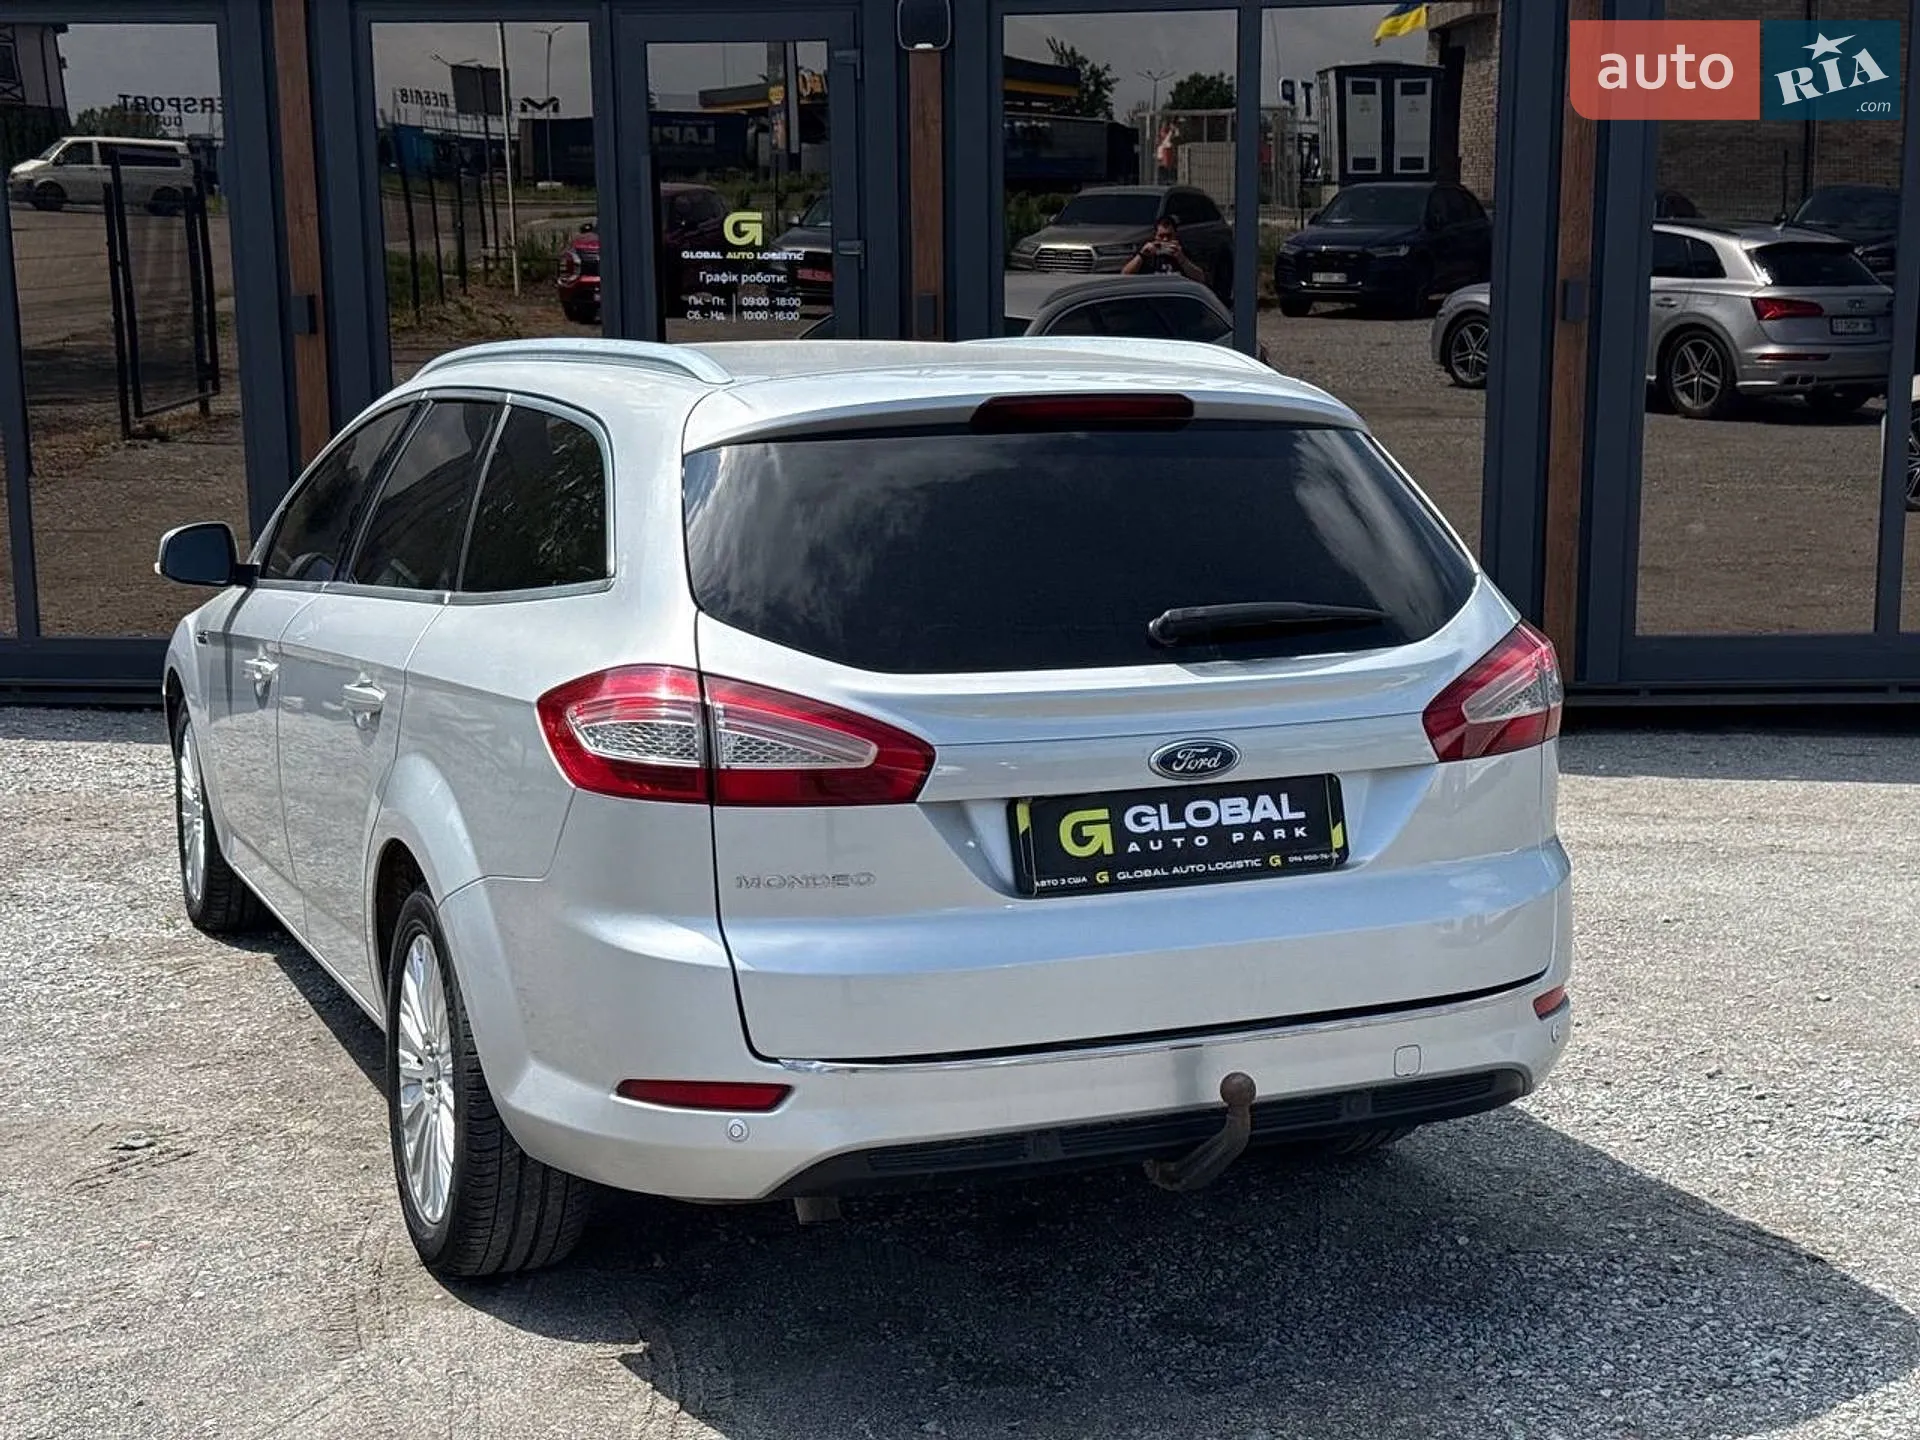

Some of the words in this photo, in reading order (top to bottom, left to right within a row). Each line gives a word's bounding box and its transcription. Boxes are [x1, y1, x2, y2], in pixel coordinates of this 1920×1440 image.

[681, 251, 724, 260] GLOBAL
[726, 251, 755, 260] AUTO
[757, 251, 805, 261] LOGISTIC
[699, 272, 739, 285] Графік
[743, 311, 768, 320] 10:00
[1172, 747, 1223, 771] Ford
[1123, 793, 1307, 833] GLOBAL
[1127, 835, 1210, 853] AUTO
[1231, 826, 1307, 844] PARK
[1116, 868, 1169, 880] GLOBAL
[1171, 863, 1207, 875] AUTO
[1209, 858, 1262, 871] LOGISTIC
[736, 872, 877, 889] MONDEO
